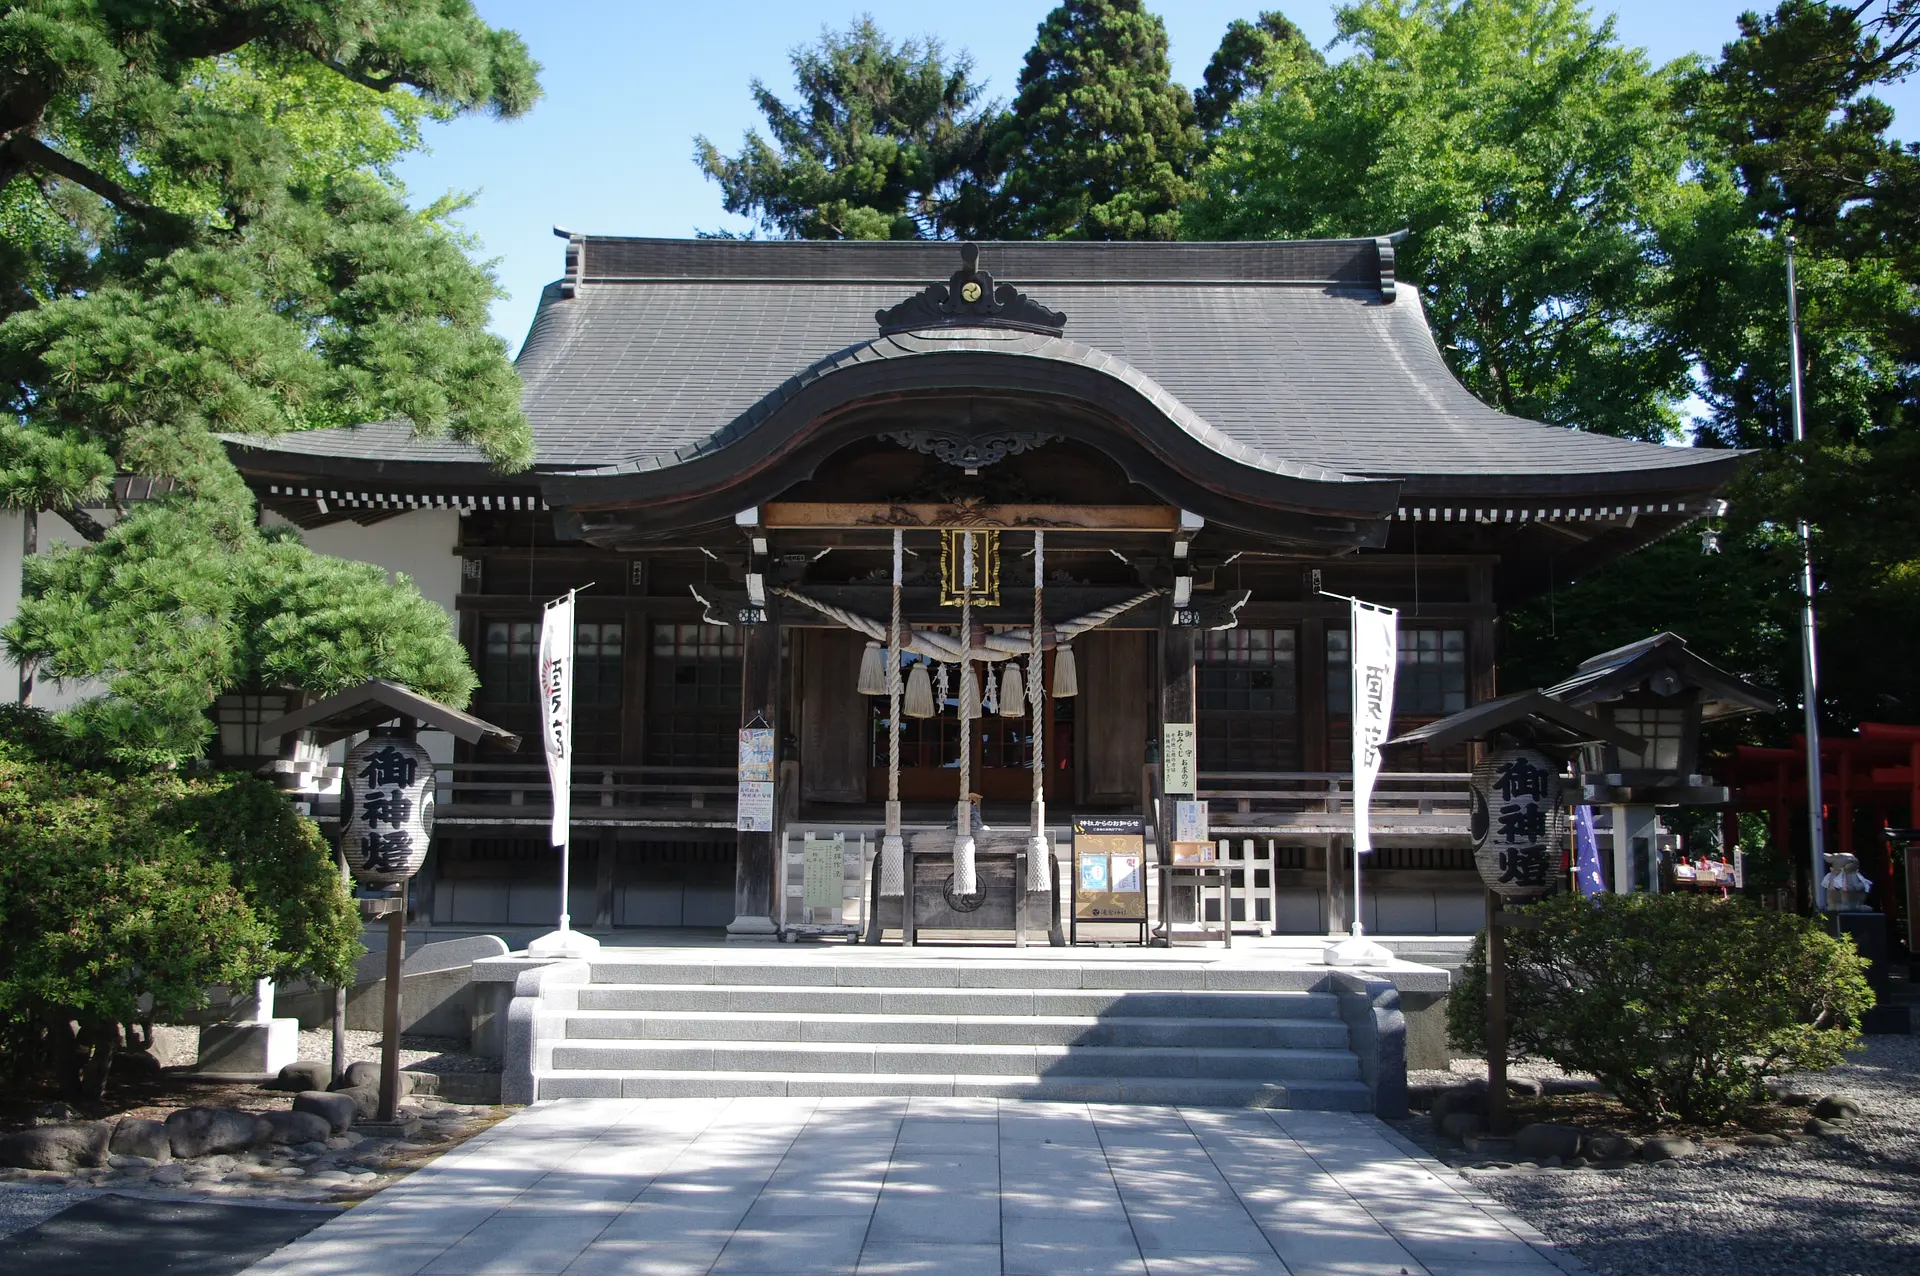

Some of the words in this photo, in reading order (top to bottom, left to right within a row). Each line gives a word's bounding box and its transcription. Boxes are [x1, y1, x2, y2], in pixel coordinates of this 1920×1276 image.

[359, 746, 418, 873] 御神燈
[1493, 757, 1549, 887] 御神燈
